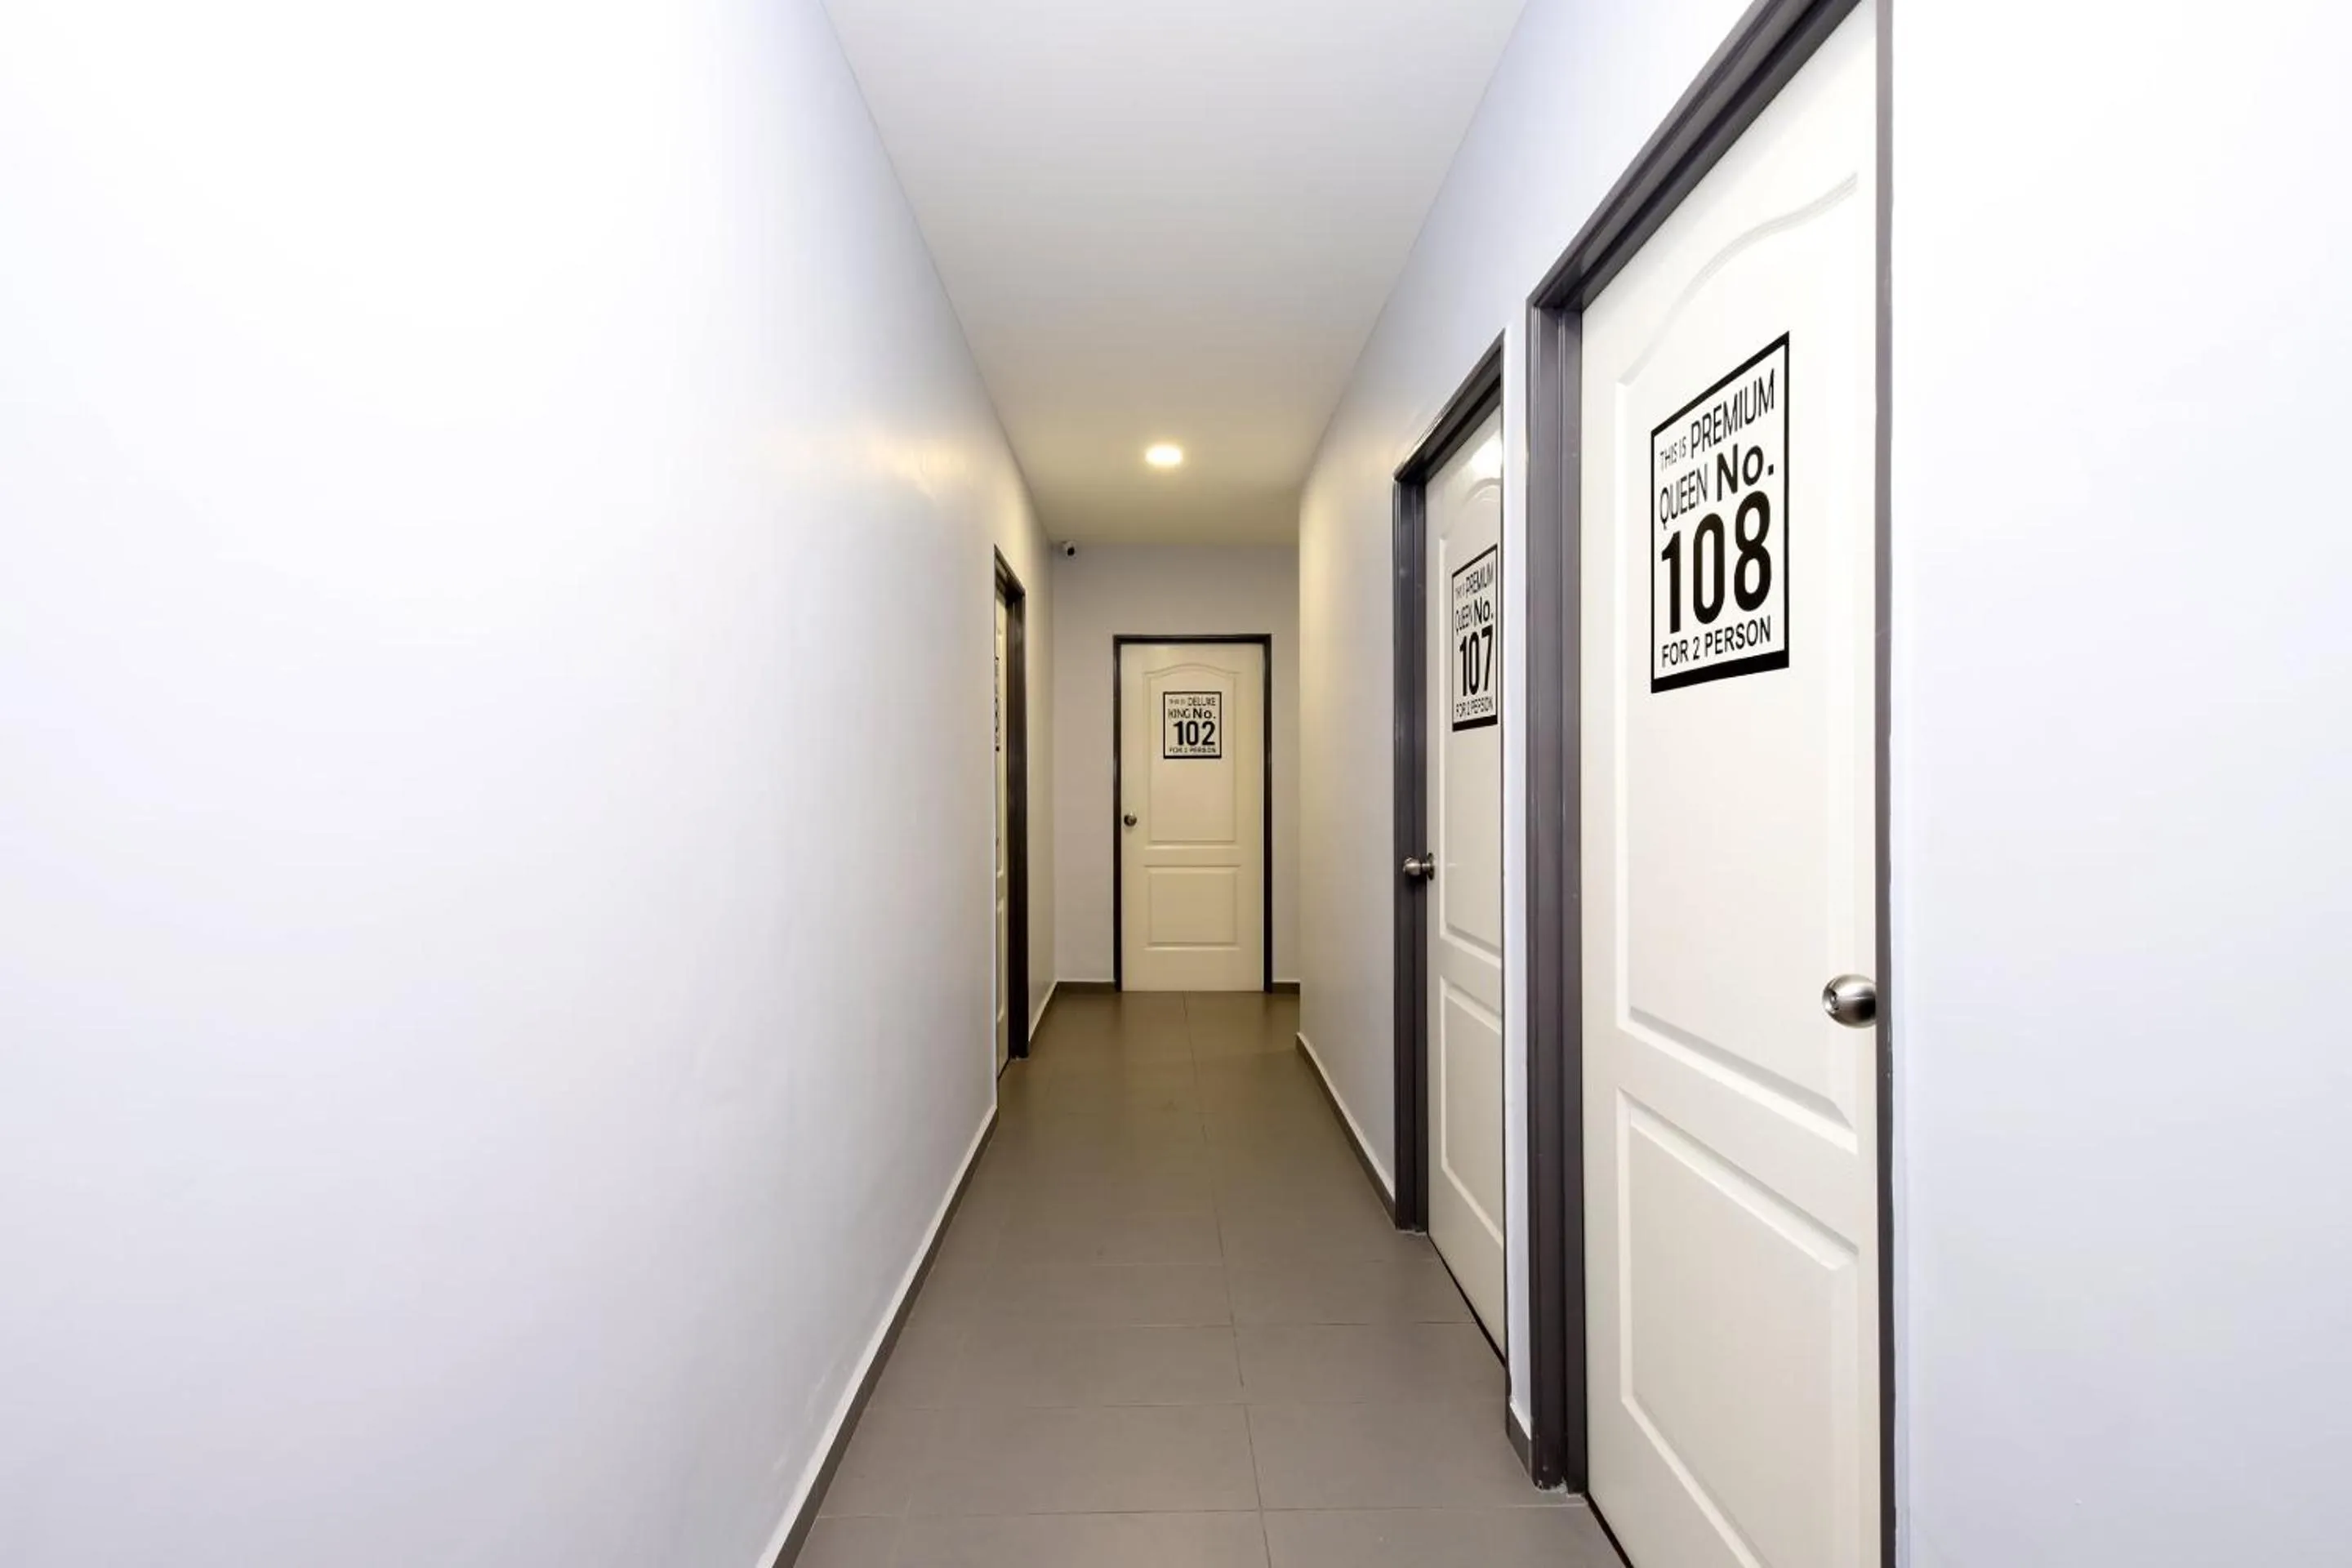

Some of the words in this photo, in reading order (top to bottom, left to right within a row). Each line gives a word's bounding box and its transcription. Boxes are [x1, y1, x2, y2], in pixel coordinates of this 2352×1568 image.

[1660, 440, 1677, 470] THIS
[1679, 435, 1686, 458] IS
[1690, 368, 1775, 459] PREMIUM
[1659, 463, 1708, 530] QUEEN
[1717, 443, 1775, 501] No.
[1661, 490, 1771, 635] 108
[1473, 596, 1493, 627] No.
[1662, 639, 1689, 668] FOR
[1692, 636, 1700, 661] 2
[1704, 615, 1771, 657] PERSON
[1459, 624, 1493, 697] 107
[1168, 708, 1191, 719] KING
[1192, 708, 1216, 719] No.
[1173, 720, 1215, 746] 102
